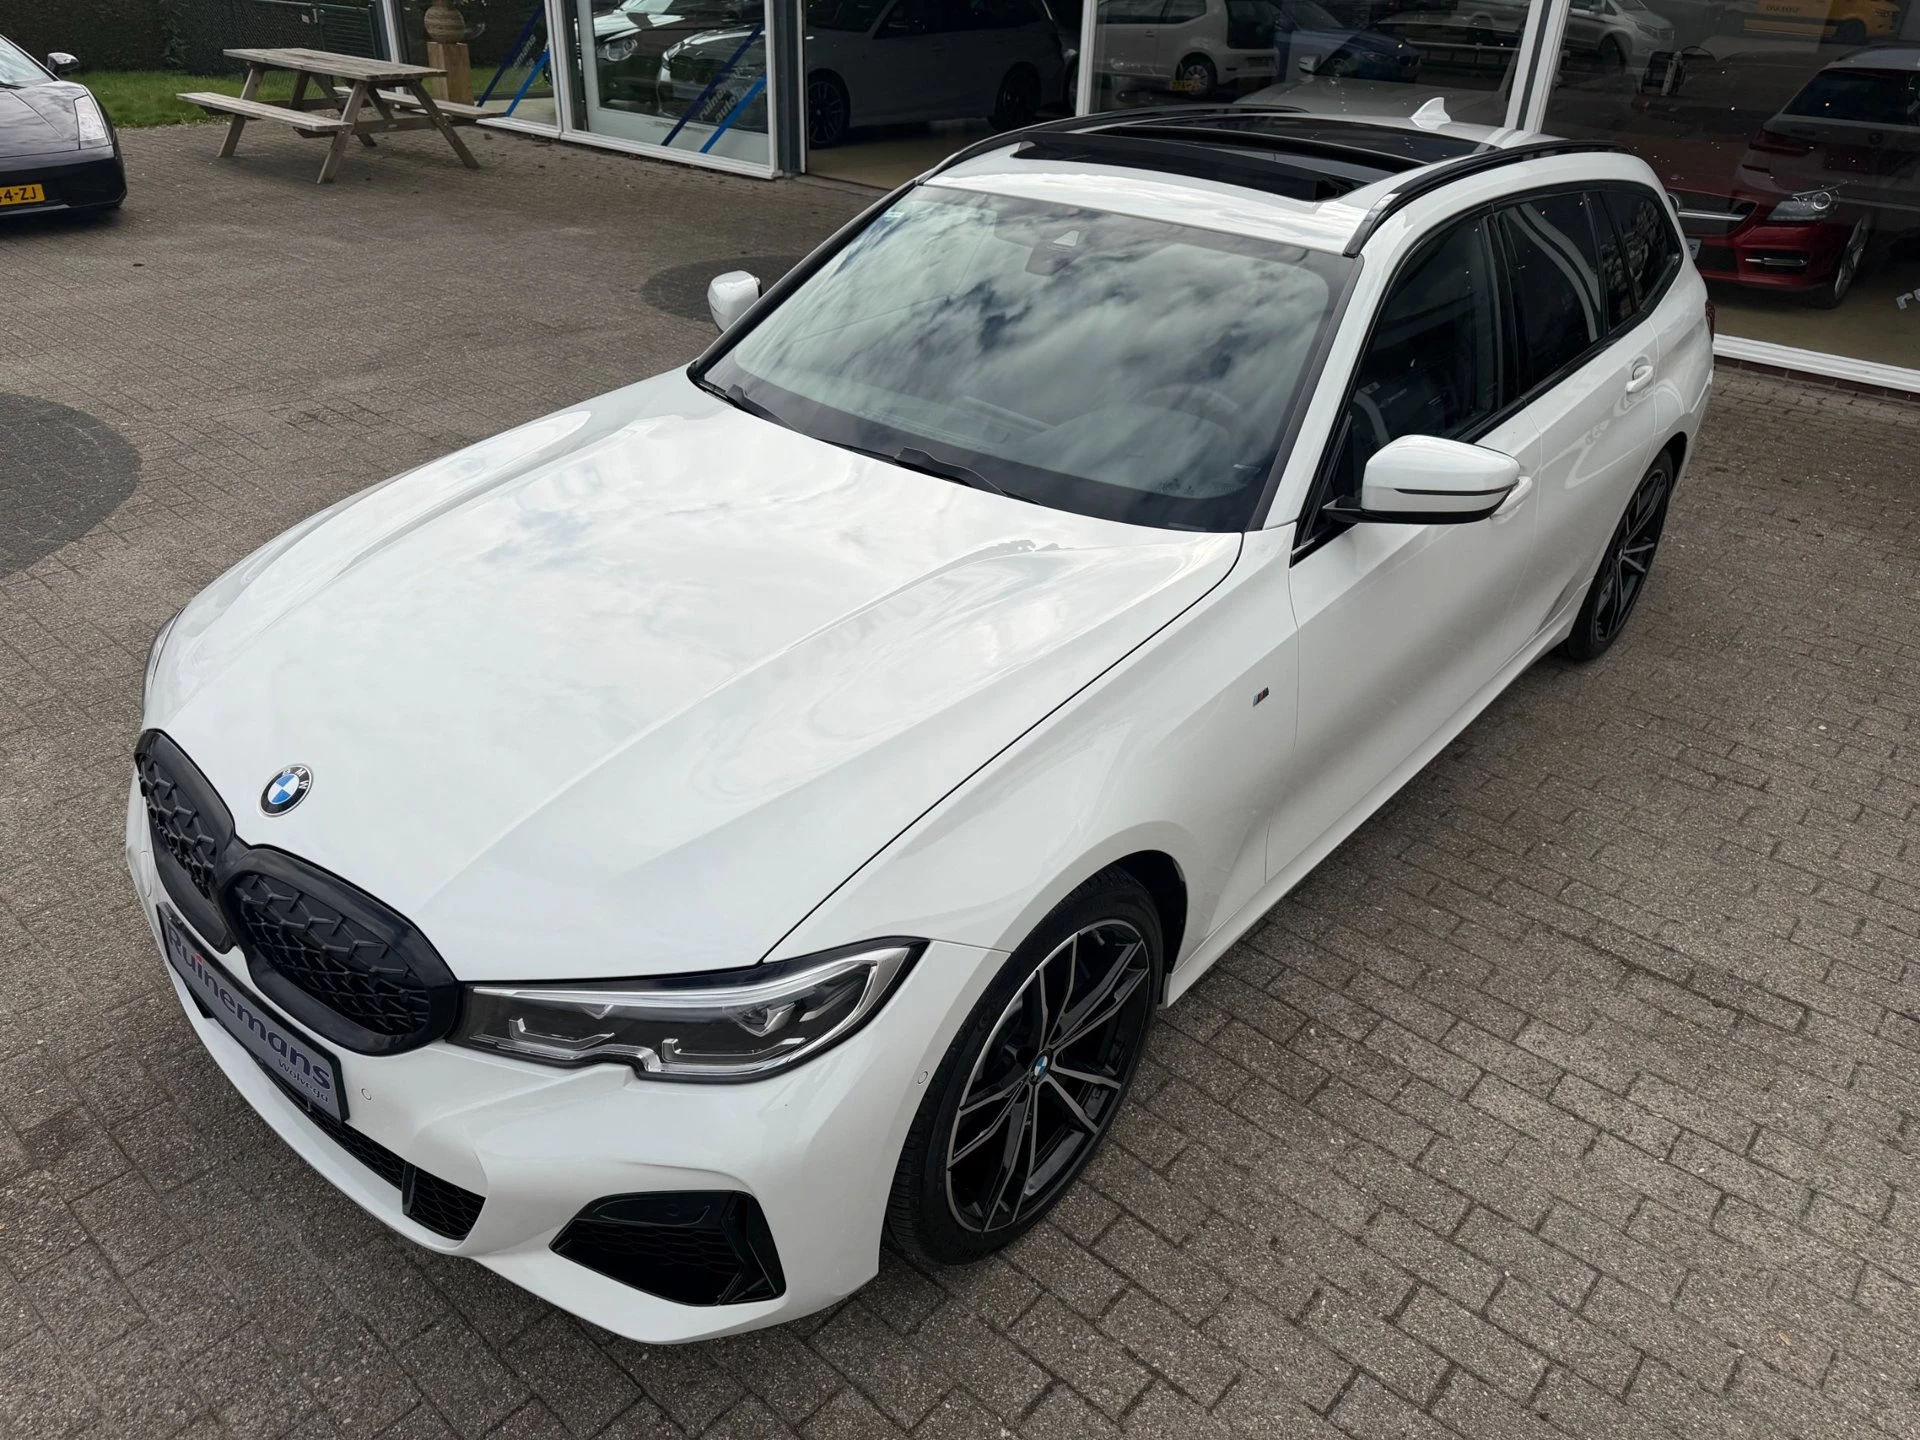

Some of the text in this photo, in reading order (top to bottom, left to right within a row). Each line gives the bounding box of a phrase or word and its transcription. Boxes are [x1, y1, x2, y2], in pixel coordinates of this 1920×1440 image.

[0, 186, 37, 203] 4-ZJ
[282, 768, 309, 790] BMW
[167, 921, 331, 1091] Ruinemans
